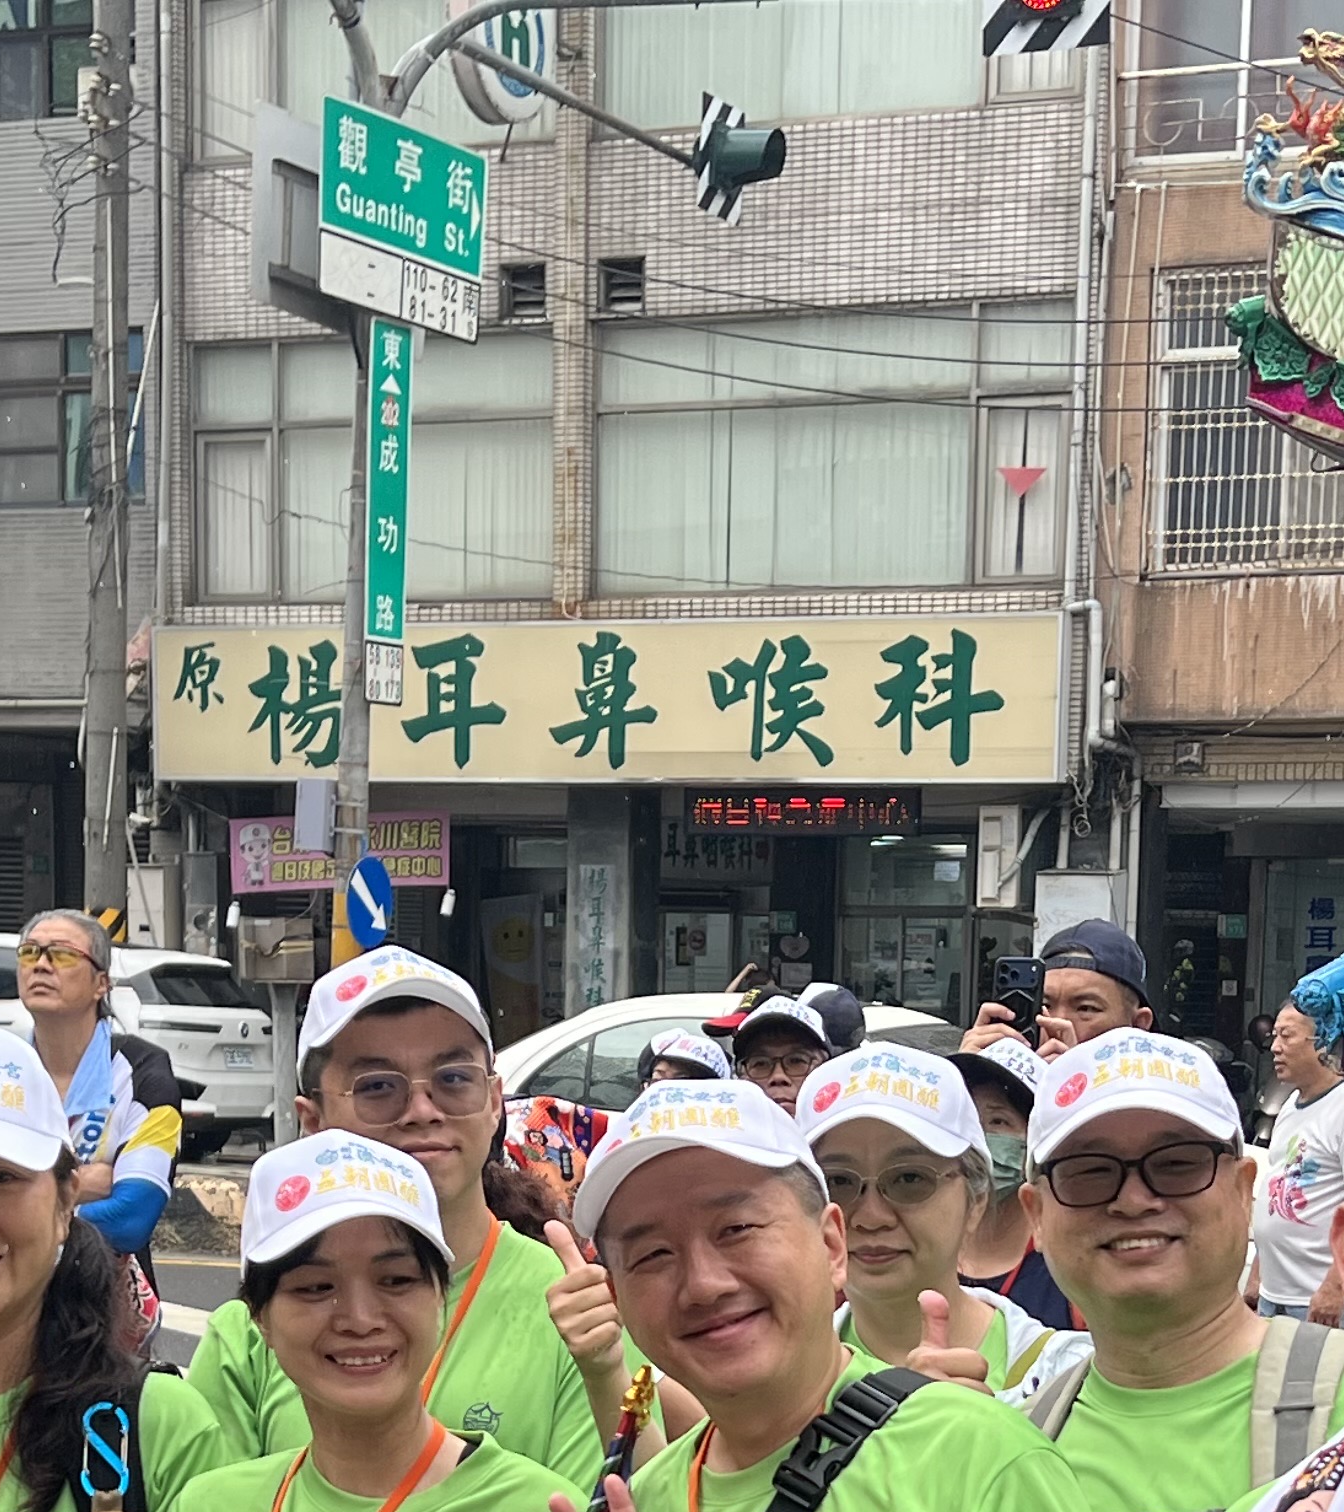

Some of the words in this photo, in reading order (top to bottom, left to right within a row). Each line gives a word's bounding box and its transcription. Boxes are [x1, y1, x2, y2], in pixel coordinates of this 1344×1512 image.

[337, 114, 473, 215] 觀亭街
[335, 182, 428, 249] Guanting
[444, 222, 470, 257] St.
[405, 263, 458, 304] 110-62
[381, 329, 402, 370] 東
[376, 434, 400, 632] 成功路
[173, 642, 225, 714] 原
[247, 628, 1006, 770] 楊耳鼻喉科
